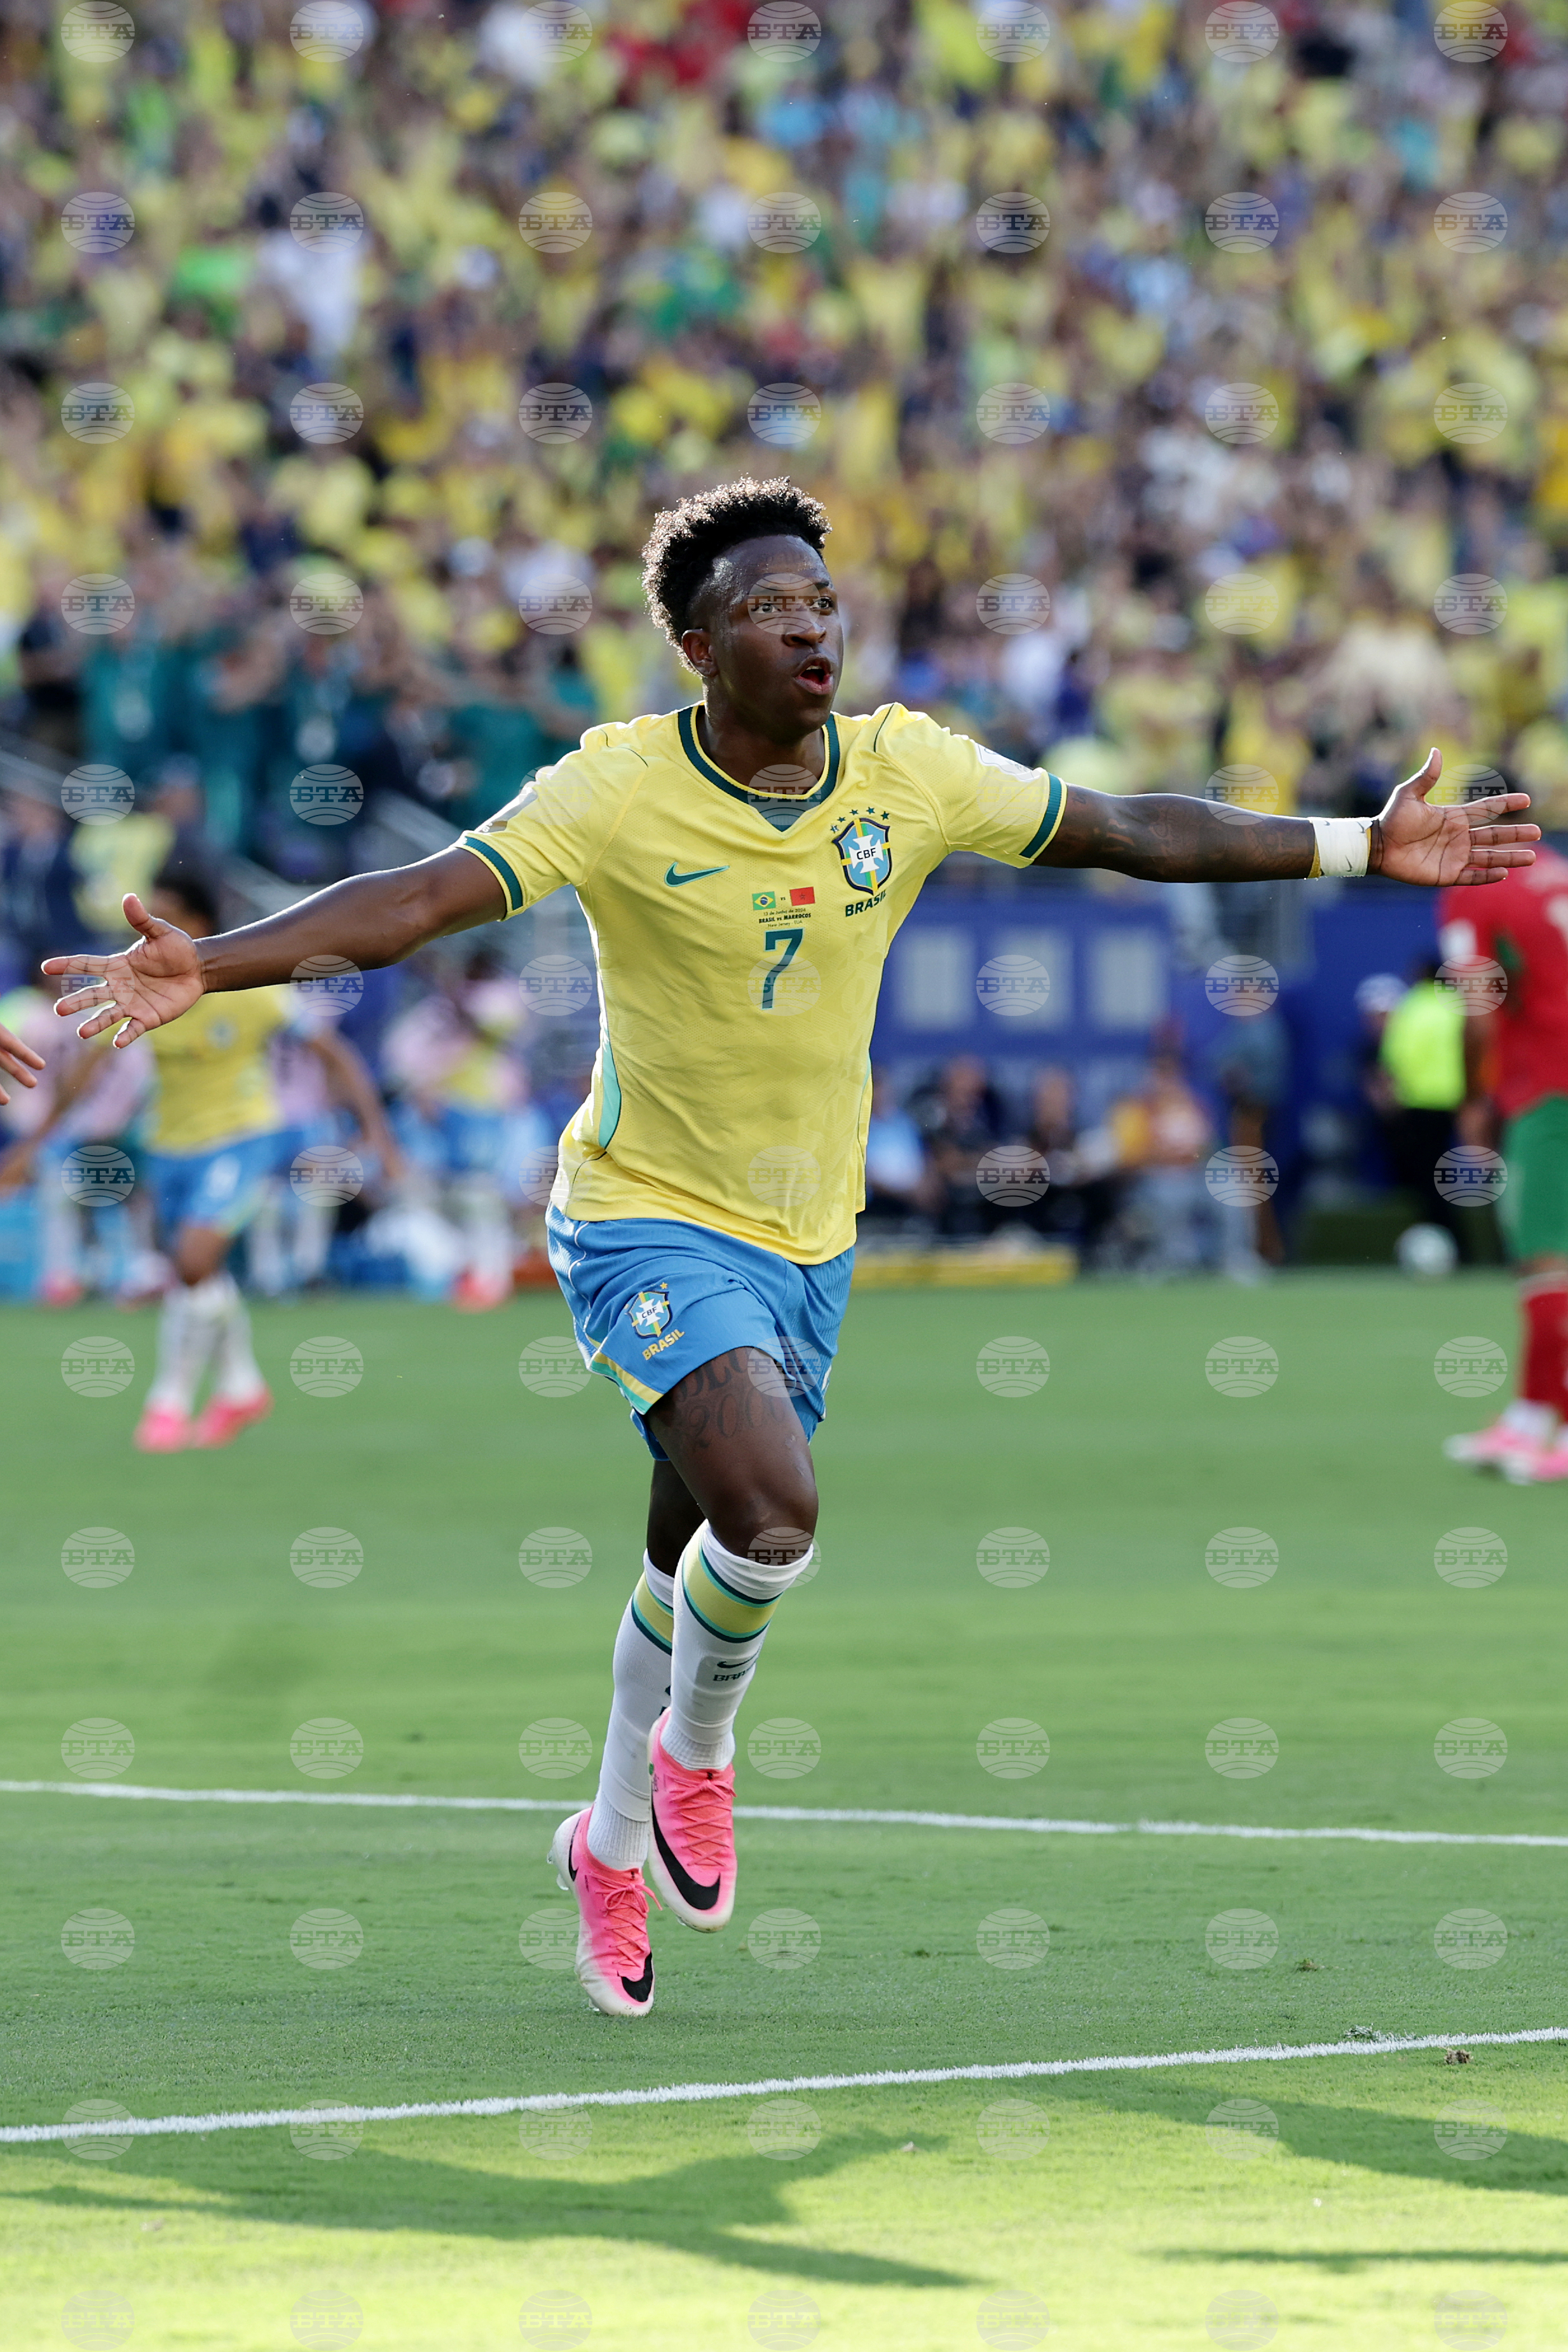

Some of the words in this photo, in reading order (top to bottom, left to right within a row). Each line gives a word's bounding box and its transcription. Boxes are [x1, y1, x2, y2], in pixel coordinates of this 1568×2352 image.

[856, 847, 876, 860] CBF
[845, 890, 887, 917] BRASIL
[761, 927, 805, 1010] 7
[641, 1306, 657, 1319] CBF
[642, 1329, 685, 1360] BRASIL
